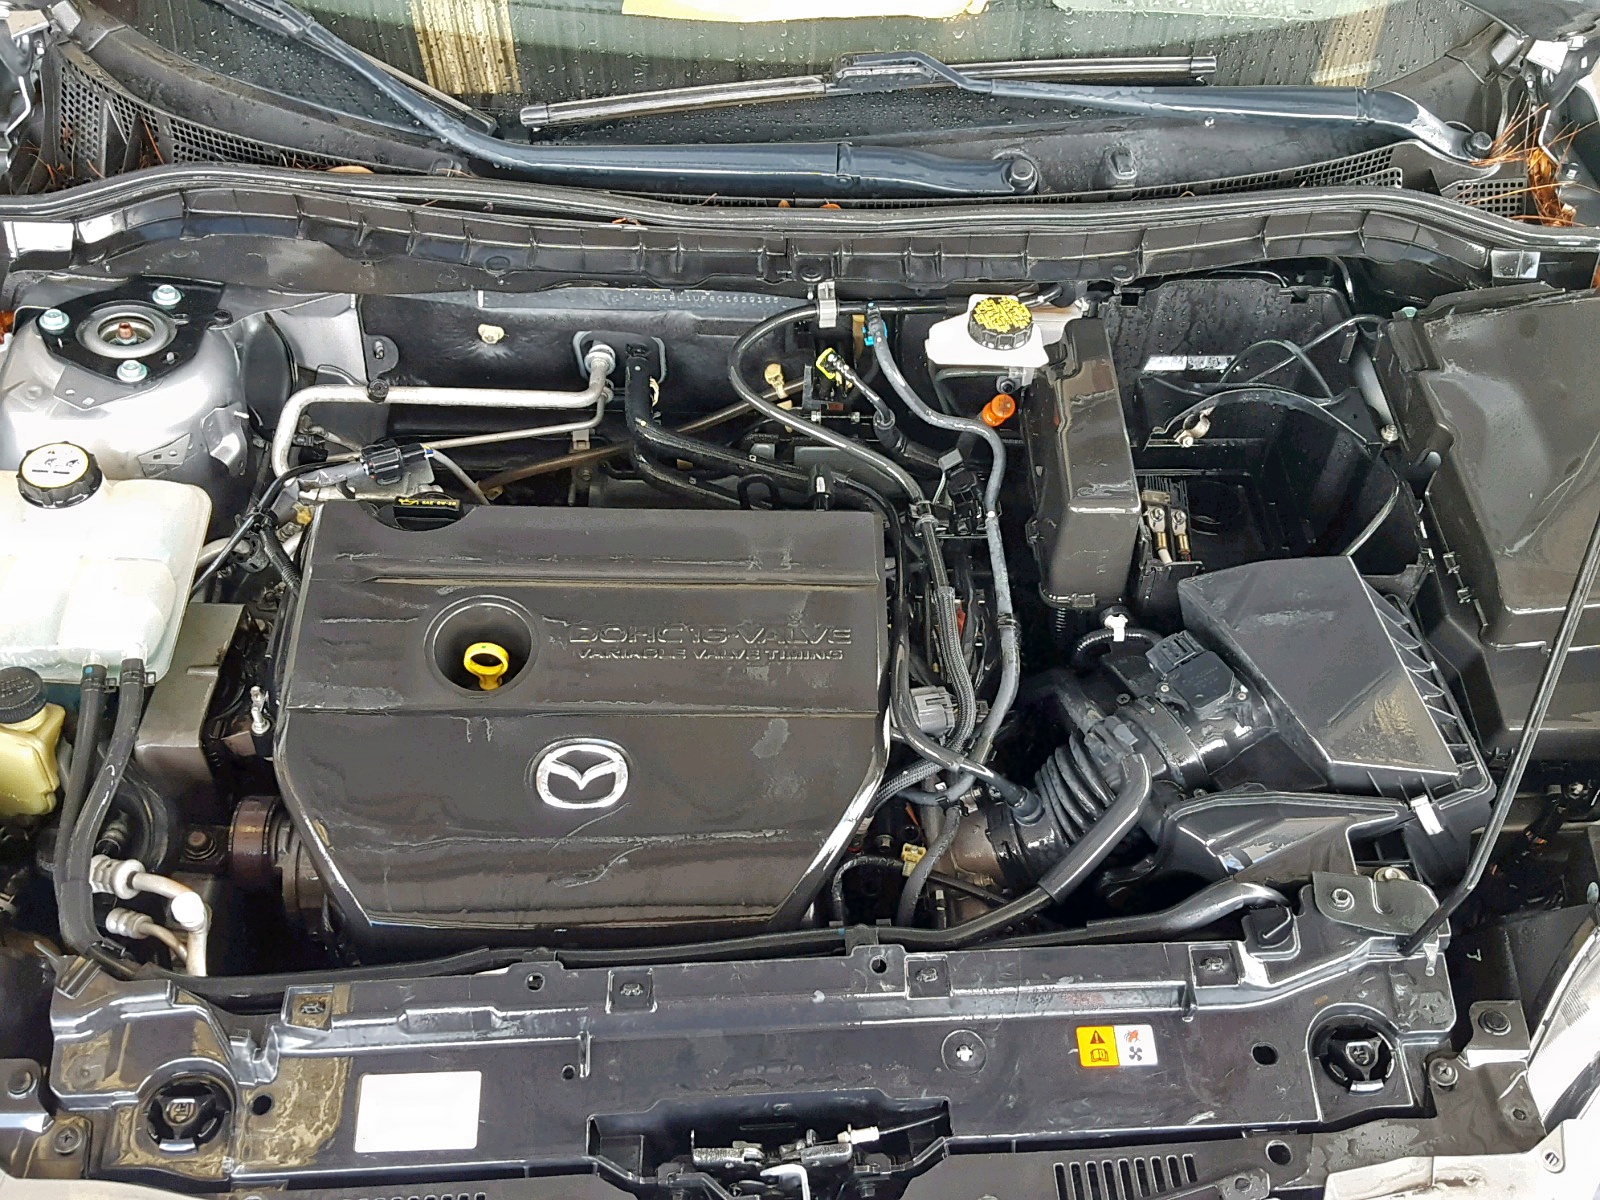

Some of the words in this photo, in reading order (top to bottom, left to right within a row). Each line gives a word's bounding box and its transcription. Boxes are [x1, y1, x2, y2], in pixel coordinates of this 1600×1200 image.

[577, 648, 687, 659] VARIABLE
[692, 648, 760, 660] VALVE
[764, 649, 843, 660] TIMING
